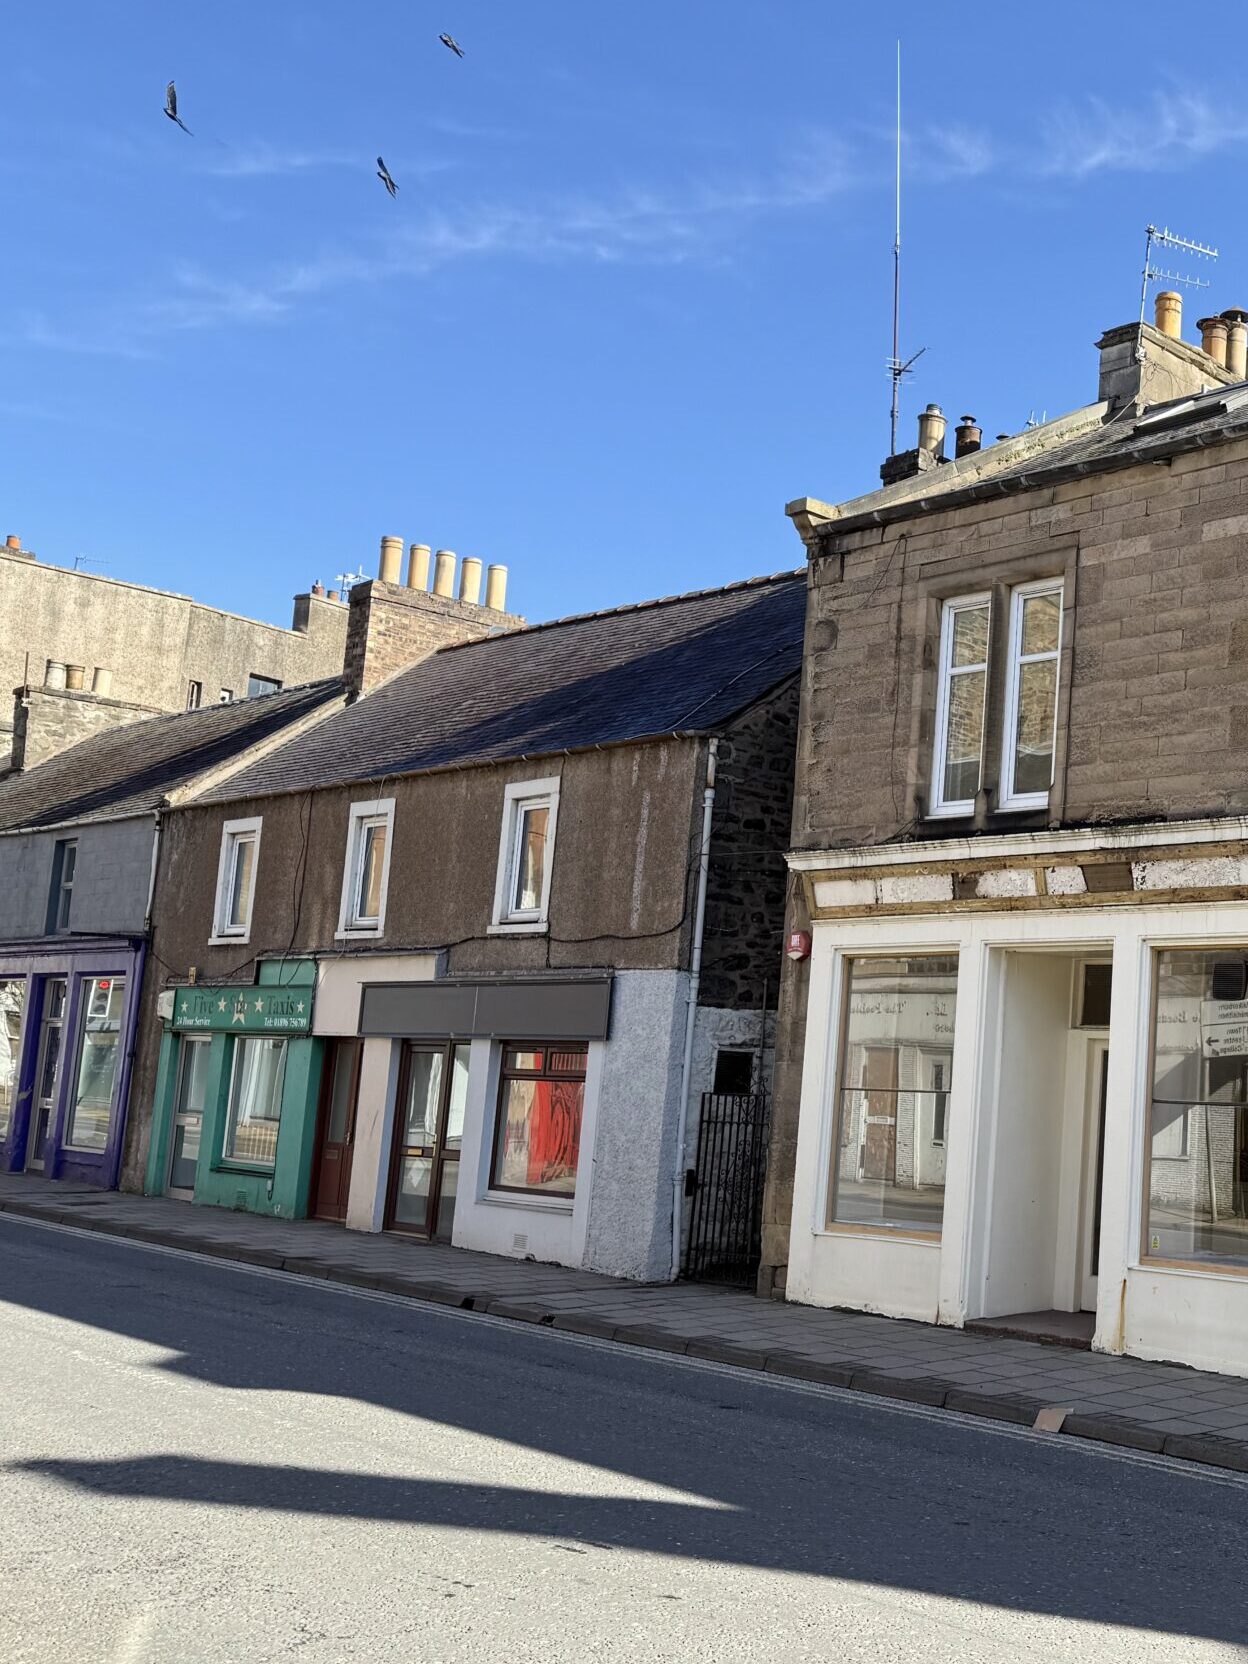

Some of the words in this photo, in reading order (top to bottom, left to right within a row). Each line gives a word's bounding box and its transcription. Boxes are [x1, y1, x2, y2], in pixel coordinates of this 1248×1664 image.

[193, 995, 214, 1015] Five
[267, 995, 294, 1016] Taxis
[183, 1016, 194, 1026] Hour
[195, 1016, 211, 1026] Service
